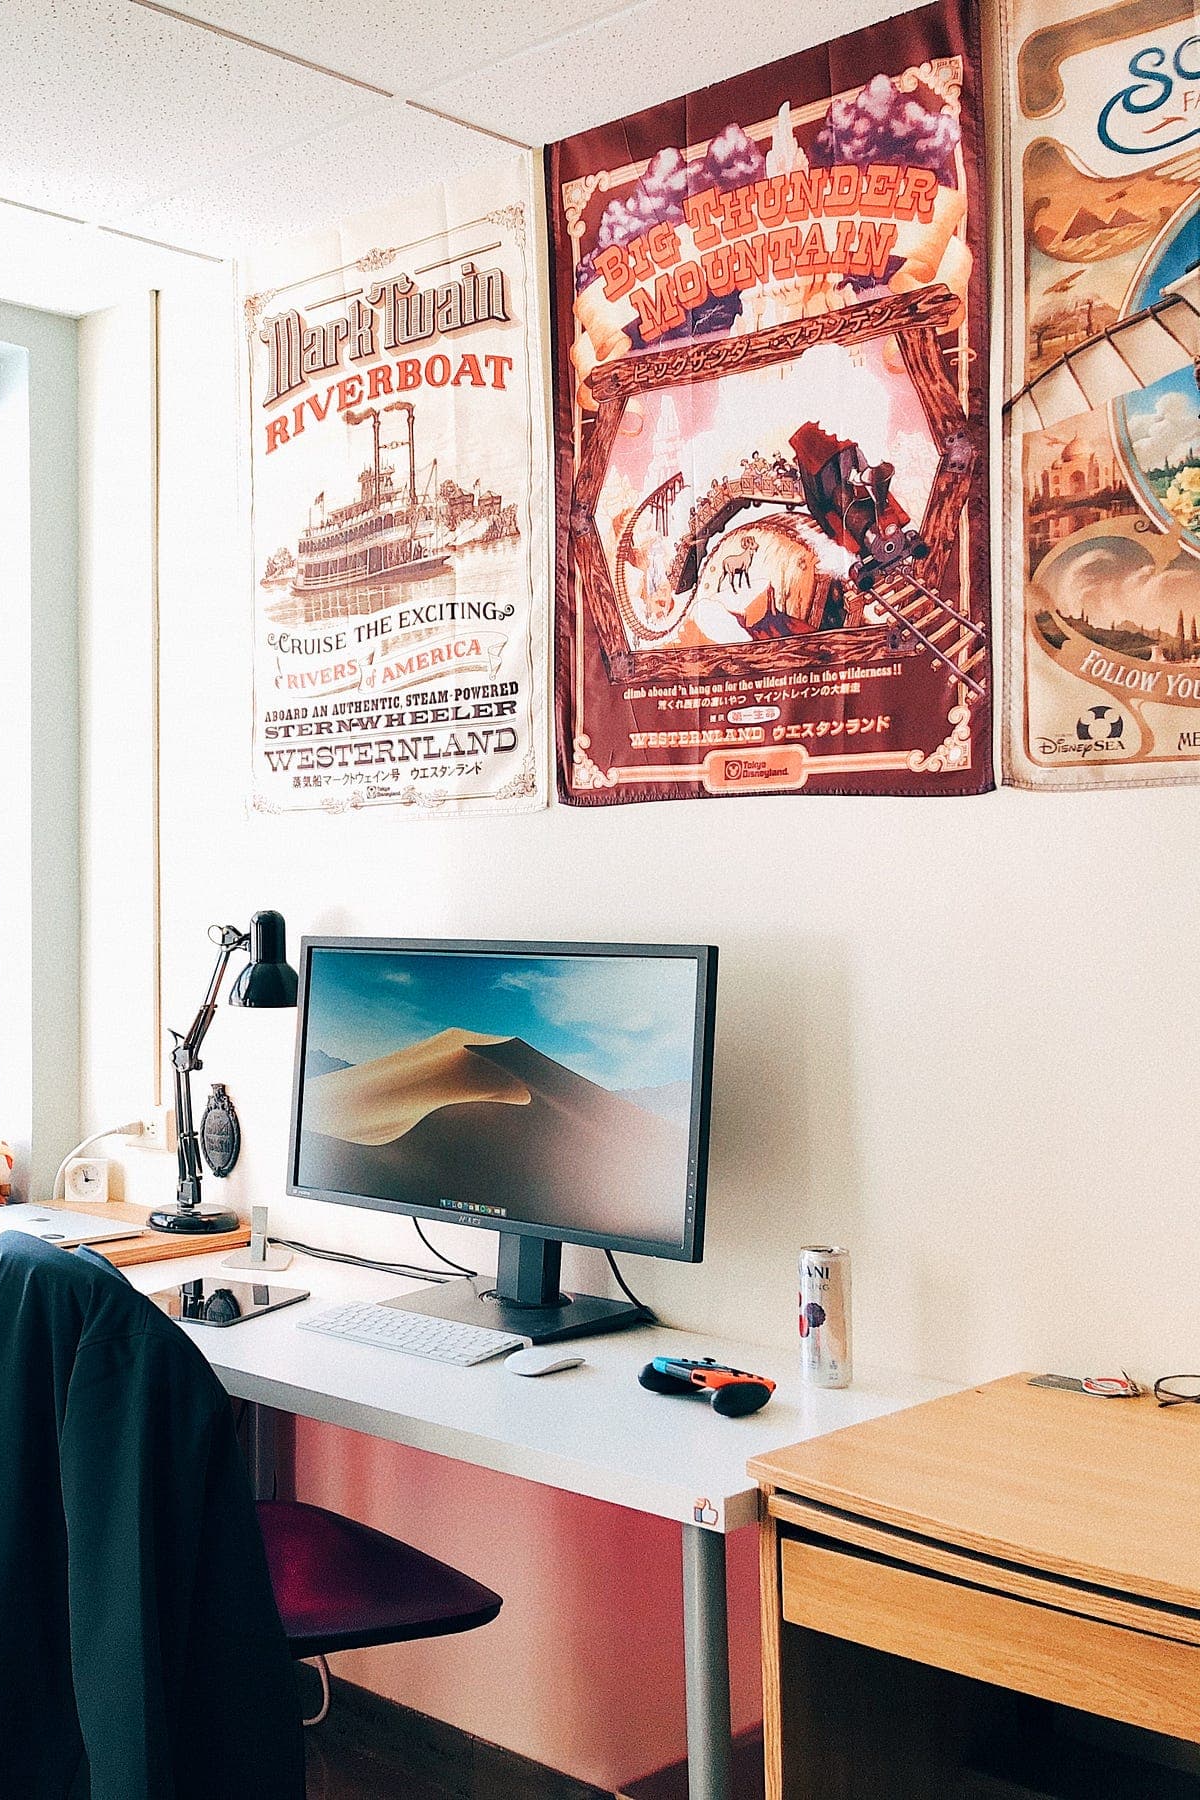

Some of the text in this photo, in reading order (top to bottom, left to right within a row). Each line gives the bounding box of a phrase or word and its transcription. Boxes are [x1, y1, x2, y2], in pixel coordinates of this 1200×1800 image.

[593, 164, 940, 302] BIG THUNDER
[629, 220, 898, 342] MOUNTAIN
[259, 262, 511, 407] Mark Twain
[265, 353, 513, 455] RIVERBOAT
[268, 601, 515, 656] CRUISE THE EXCITING
[287, 658, 358, 690] RIVERS
[365, 638, 482, 688] of AMERICA
[623, 686, 647, 700] climb
[648, 685, 677, 697] aboard
[689, 683, 711, 696] hang
[712, 683, 723, 693] on
[725, 680, 738, 691] for
[739, 680, 753, 690] the
[754, 675, 787, 689] wildest
[788, 672, 809, 684] ride
[809, 671, 820, 683] in
[822, 670, 838, 682] the
[1079, 649, 1162, 693] FOLLOW
[265, 707, 308, 722] ABOARD
[312, 705, 328, 718] AN
[265, 700, 518, 739] STERN-WHEELER
[629, 715, 891, 749] WESTERNLAND ウエスタンランド
[264, 727, 518, 773] WESTERNLAND
[411, 761, 483, 780] ウエスタンランド
[743, 761, 766, 770] Tokyo
